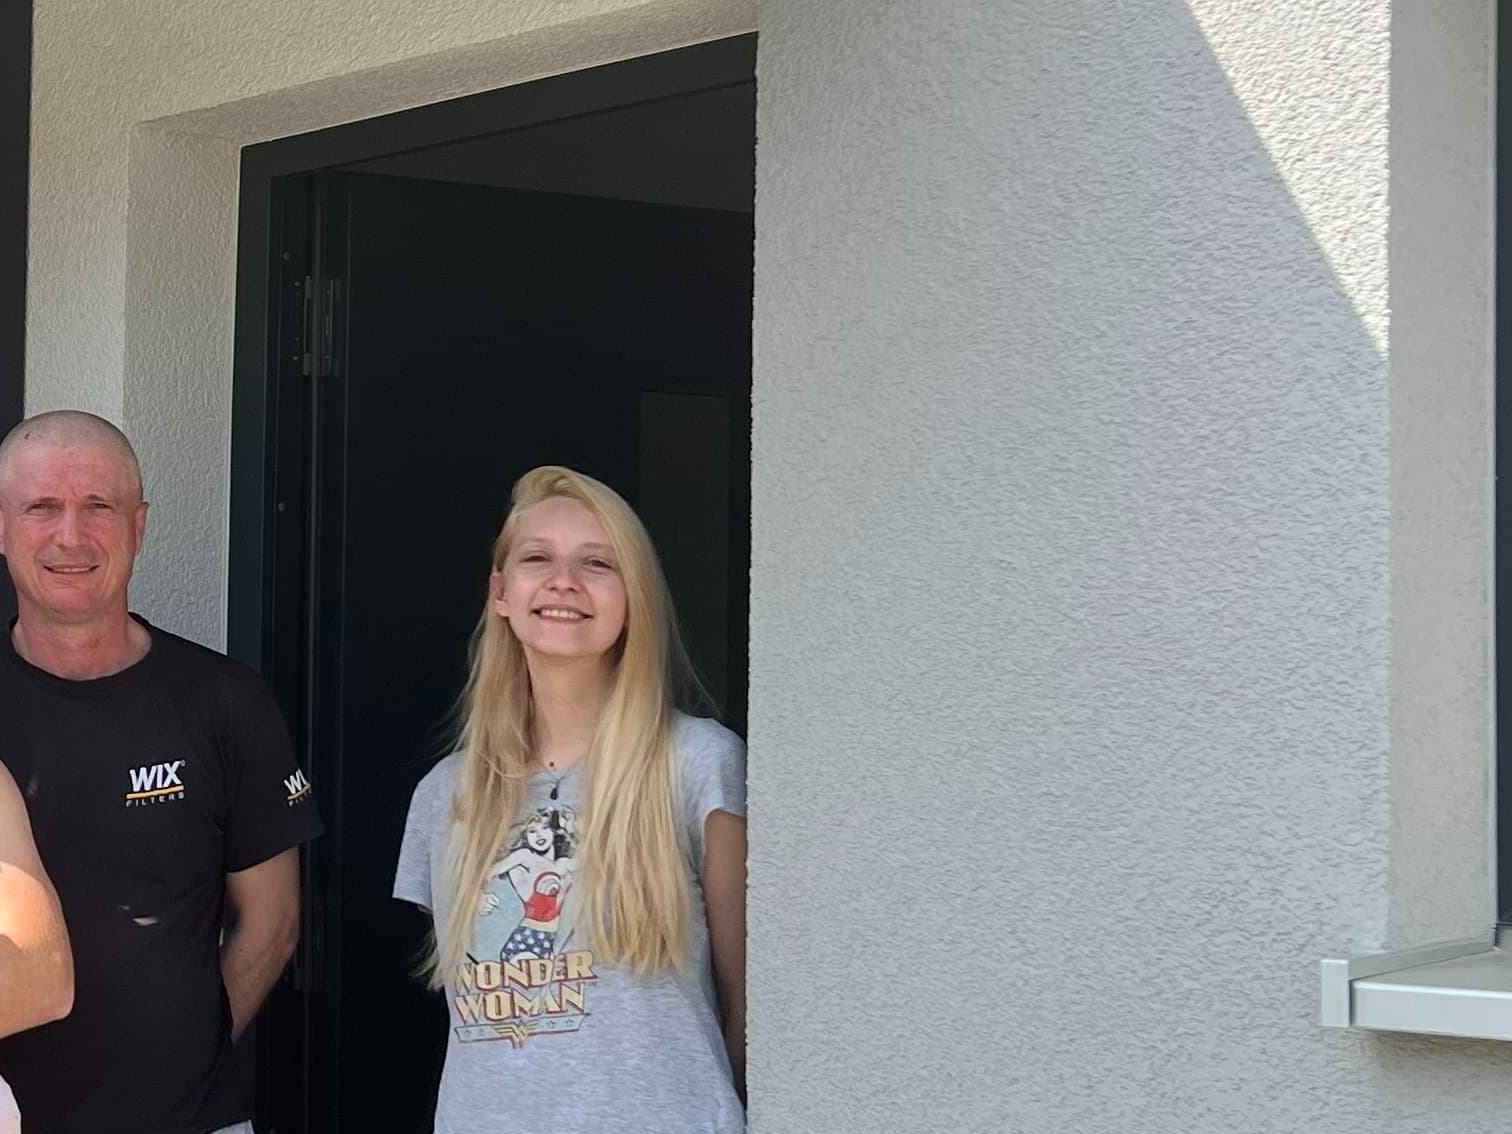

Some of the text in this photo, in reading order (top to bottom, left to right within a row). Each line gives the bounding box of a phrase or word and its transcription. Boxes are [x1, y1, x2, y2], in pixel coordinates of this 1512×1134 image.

[129, 761, 183, 792] WIX
[283, 768, 309, 795] WI
[126, 791, 185, 807] FILTERS
[454, 951, 598, 993] WONDER
[455, 982, 585, 1023] WOMAN
